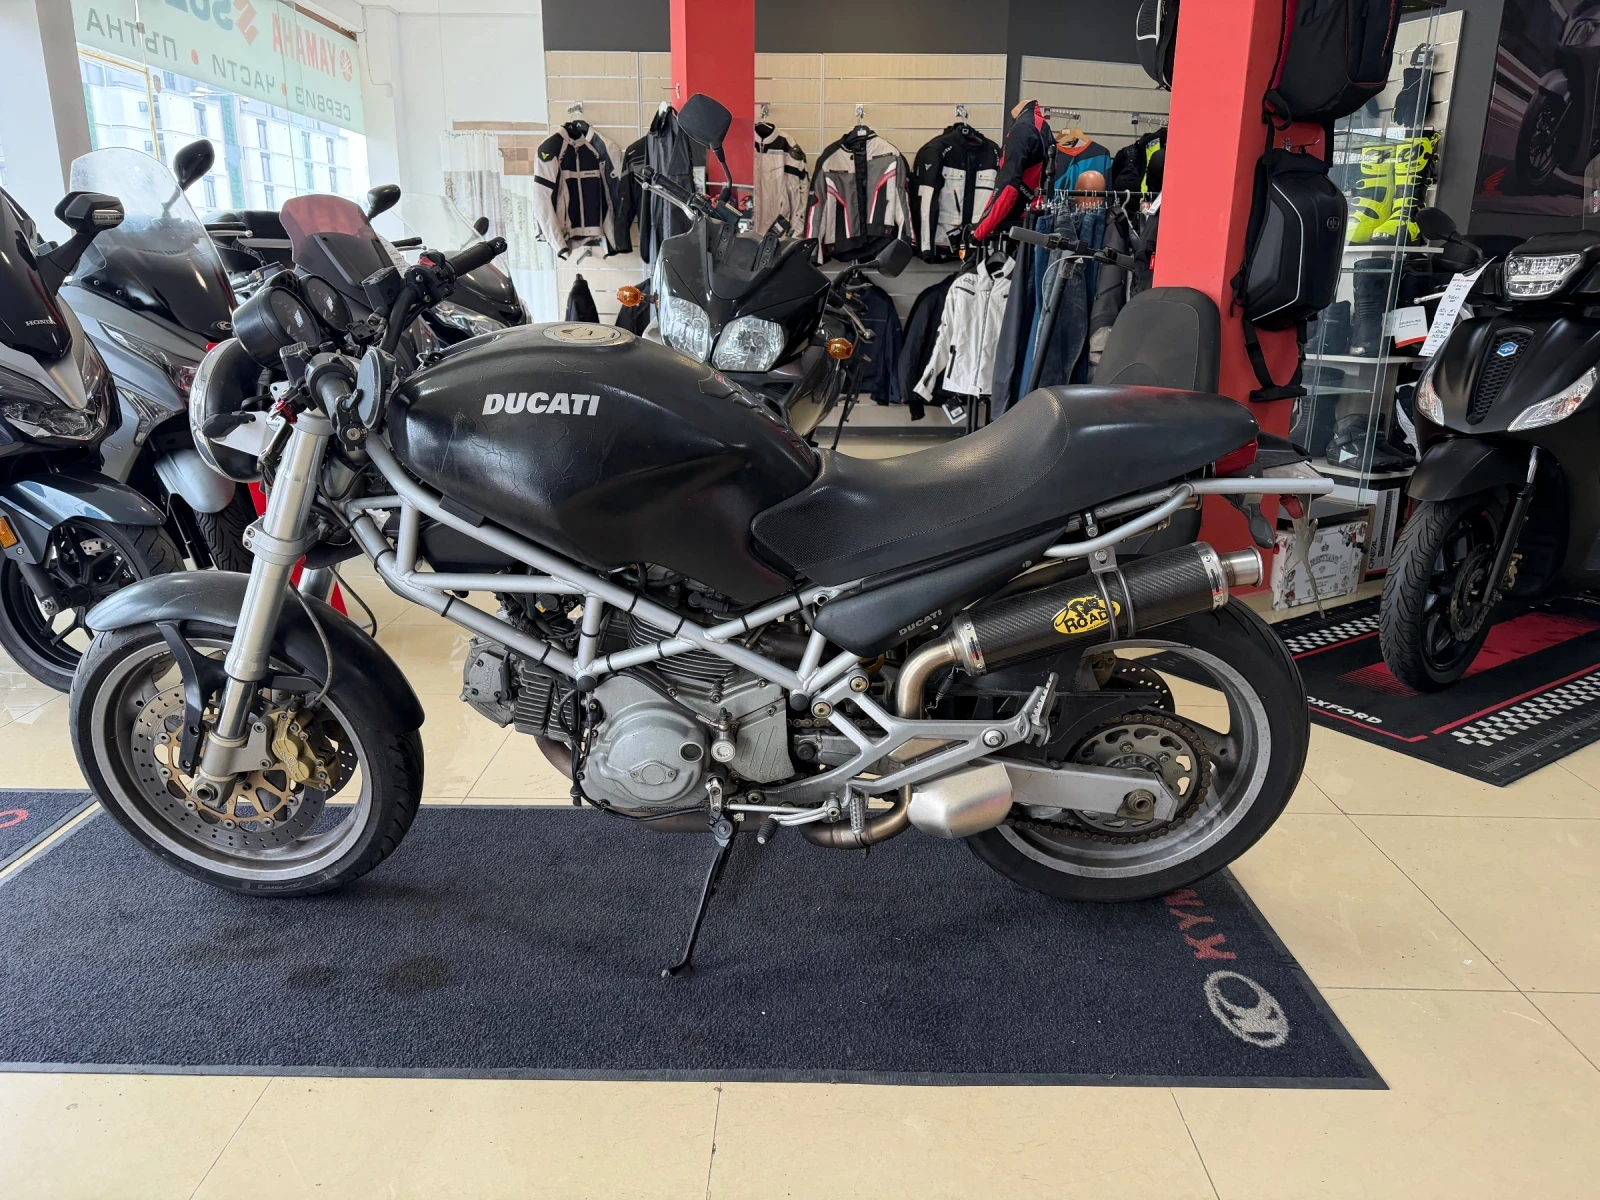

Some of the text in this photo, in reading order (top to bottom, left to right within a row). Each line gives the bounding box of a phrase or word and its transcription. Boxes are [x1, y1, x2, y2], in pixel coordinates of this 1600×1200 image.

[481, 391, 601, 416] DUCATI
[898, 608, 943, 636] DUCATI
[1063, 610, 1110, 633] ROAD
[1307, 695, 1384, 724] OXFORD
